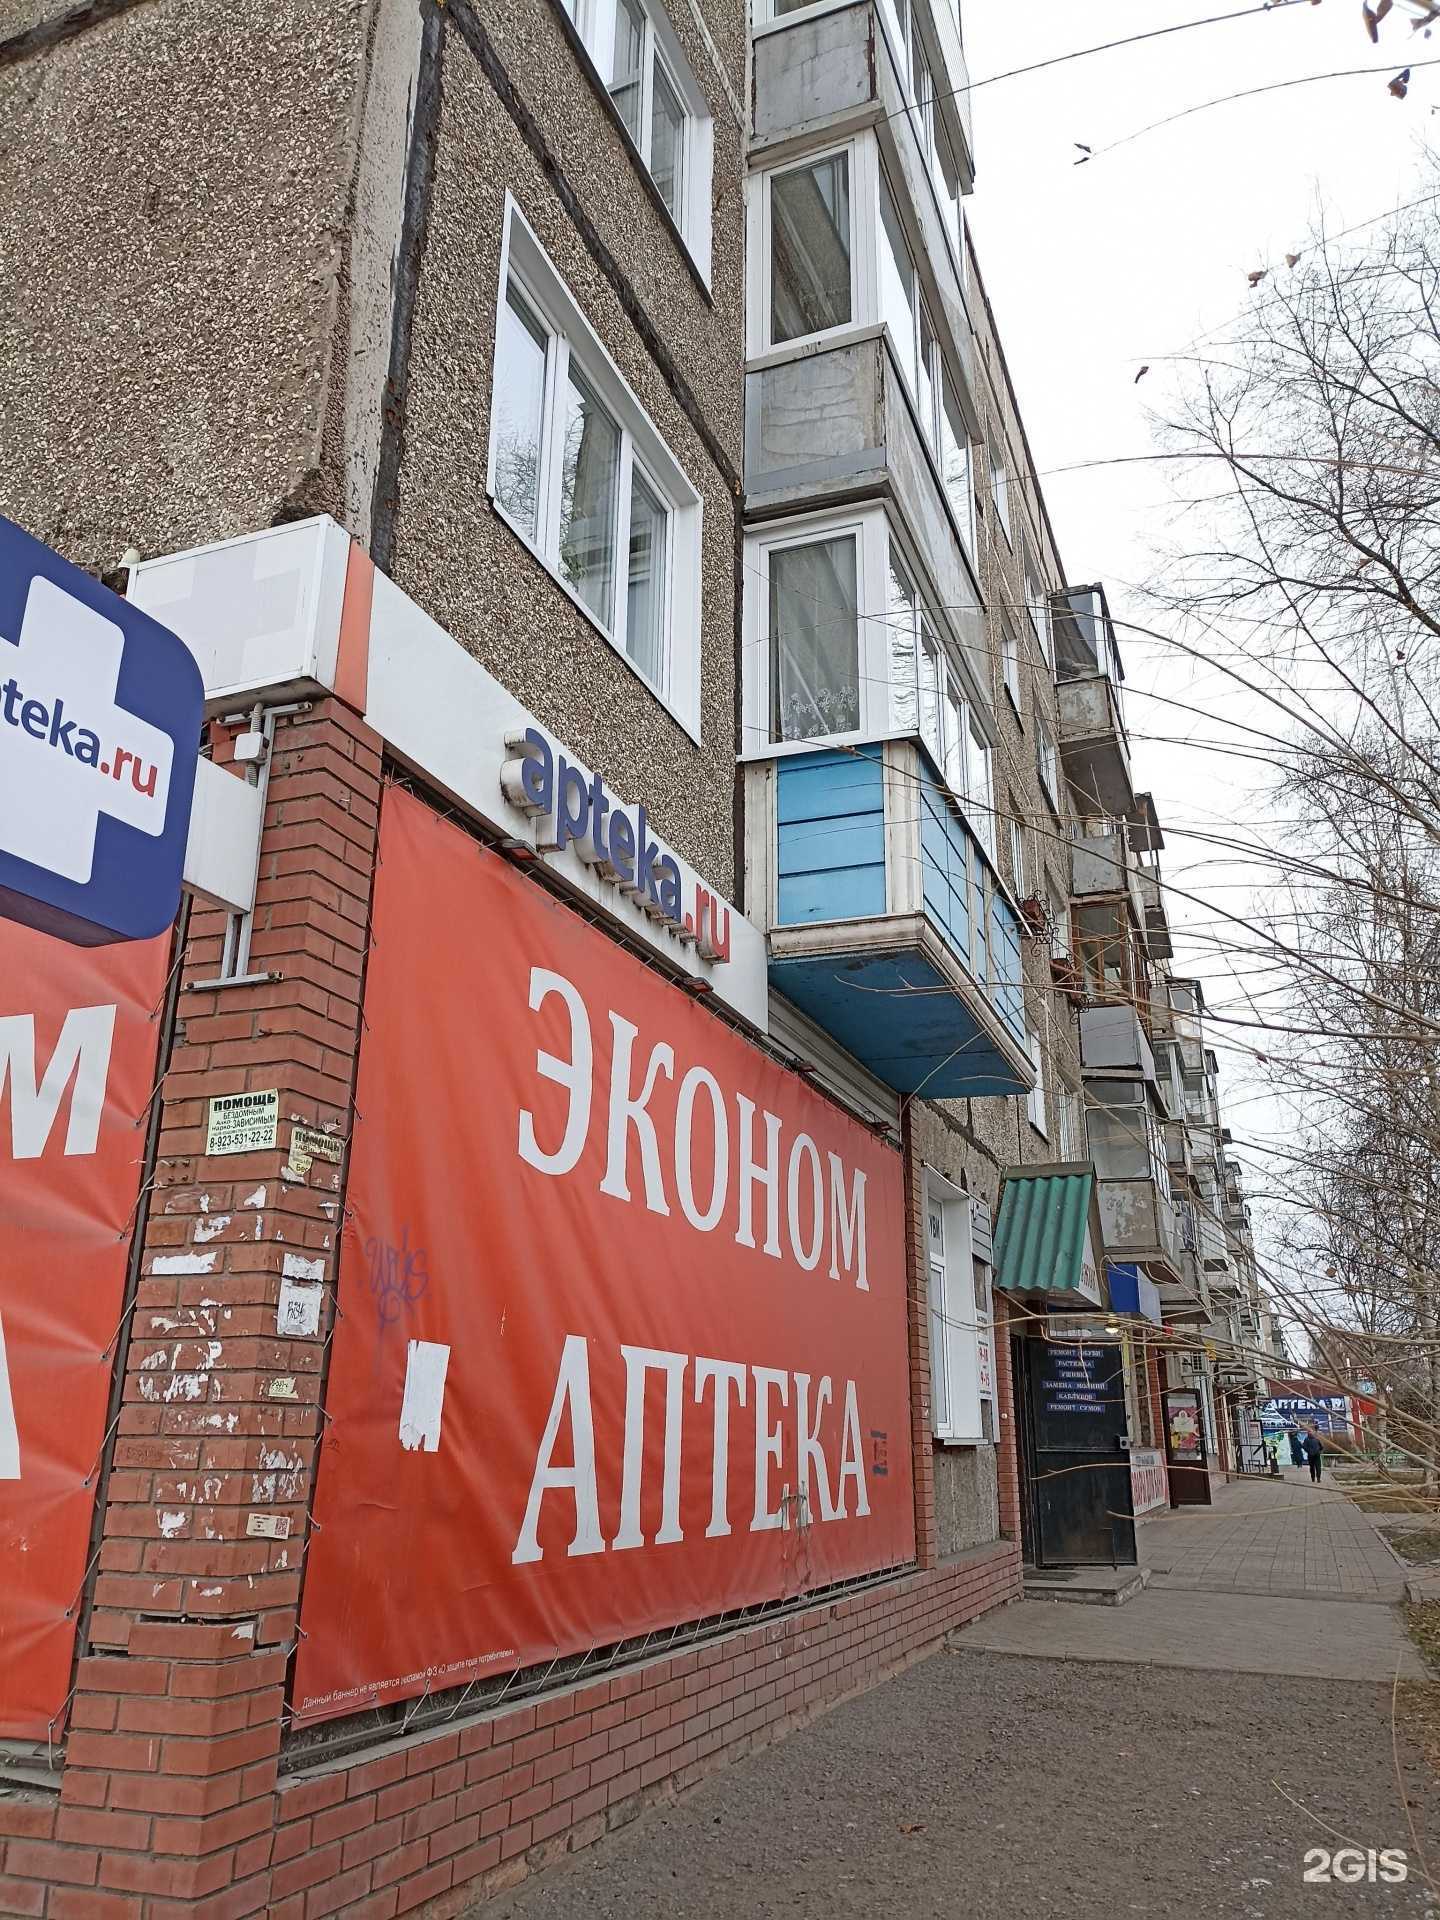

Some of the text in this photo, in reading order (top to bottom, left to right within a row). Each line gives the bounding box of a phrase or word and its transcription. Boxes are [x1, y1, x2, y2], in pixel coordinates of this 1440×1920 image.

[0, 678, 158, 798] teka.ru
[510, 727, 731, 964] apteka.ru
[209, 1129, 273, 1148] 8-923-531-22-22
[213, 1093, 276, 1112] ПОМОЩЬ
[223, 1107, 265, 1120] БЕЗДОМНЫМ
[518, 966, 871, 1293] ЭКОНОМ
[511, 1333, 872, 1565] АПТЕКА
[302, 1694, 332, 1709] Данный
[332, 1687, 359, 1702] баннер
[359, 1685, 368, 1695] не
[426, 1665, 438, 1678] ФЗ
